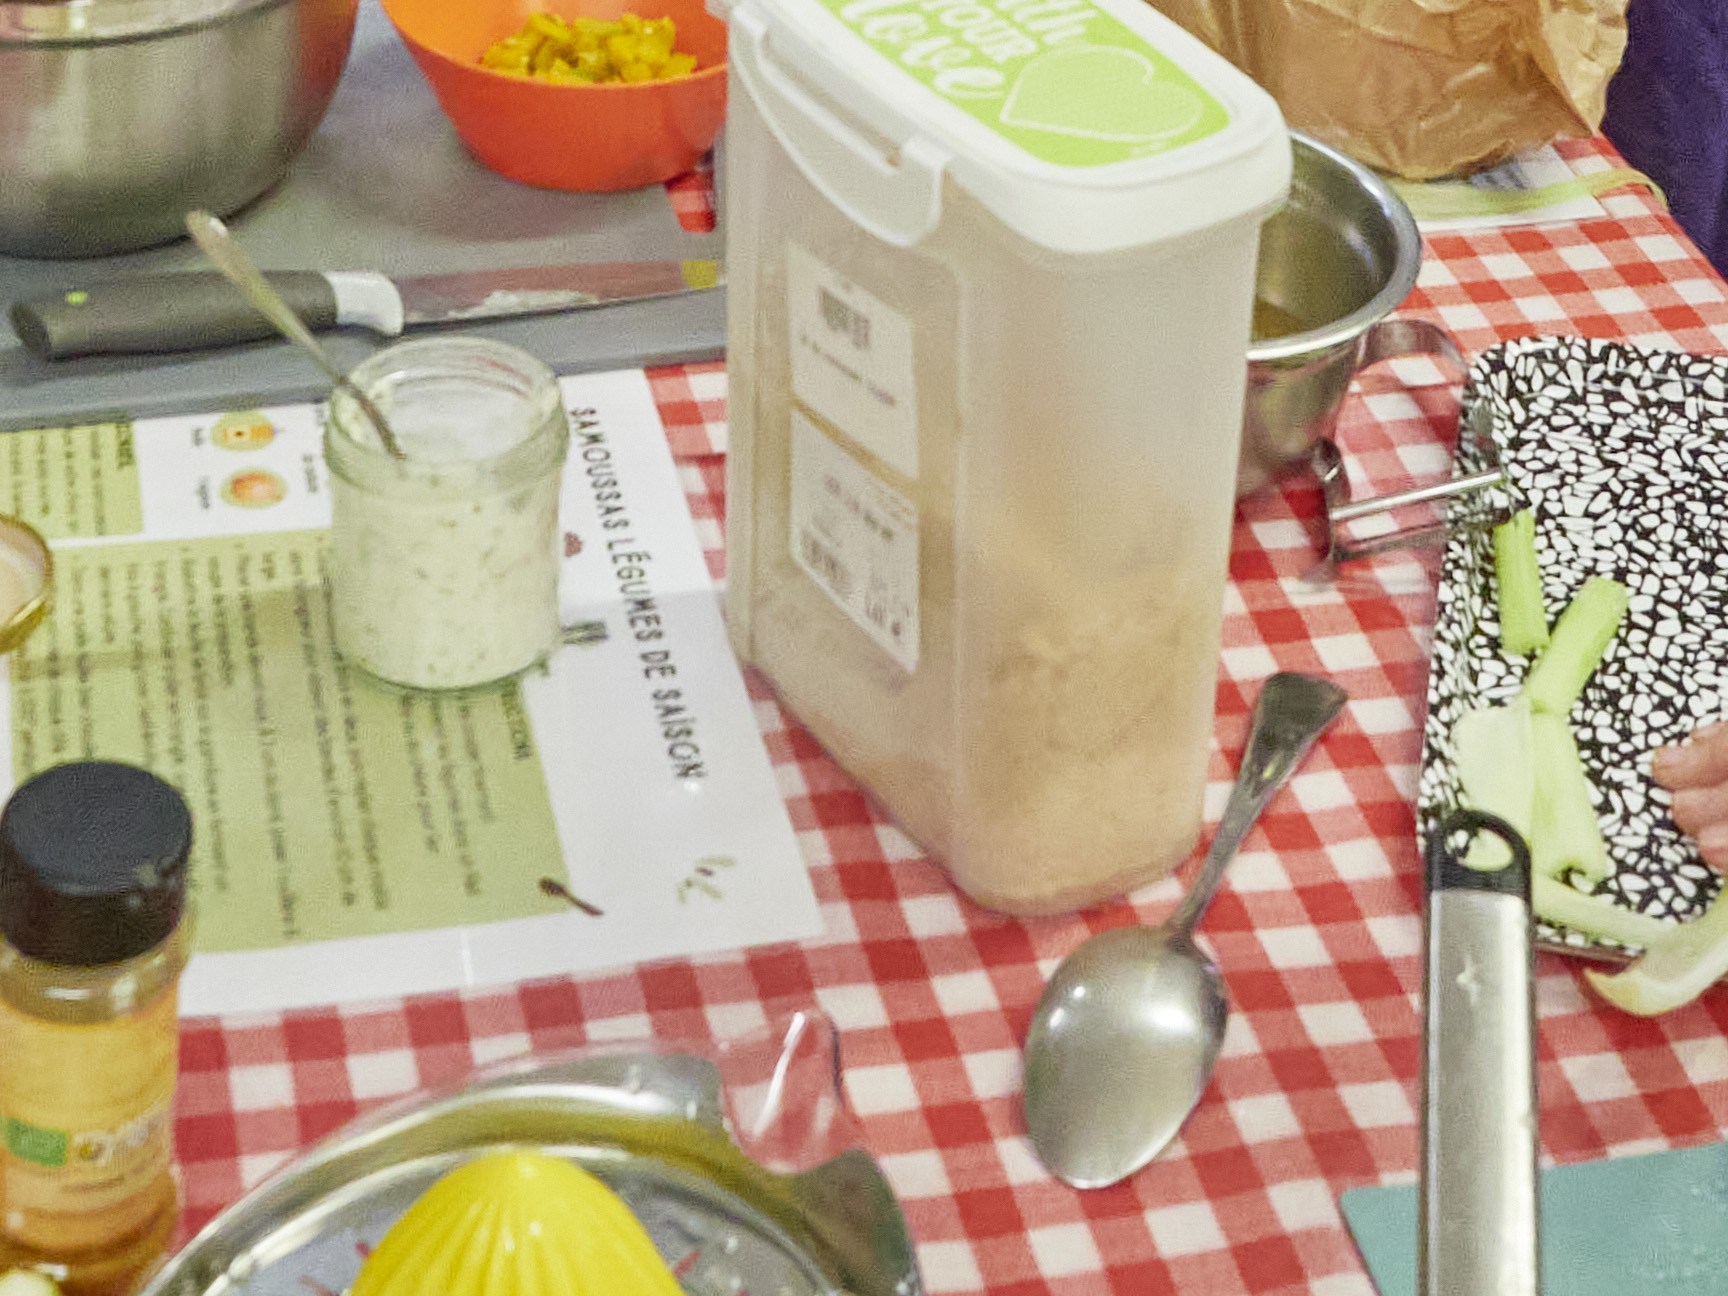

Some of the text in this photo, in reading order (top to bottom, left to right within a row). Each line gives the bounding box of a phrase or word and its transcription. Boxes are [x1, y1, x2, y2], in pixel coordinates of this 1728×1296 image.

[569, 406, 631, 533] SAMOUSSAS
[606, 535, 665, 645] LÉGUMES
[639, 648, 678, 680] DE
